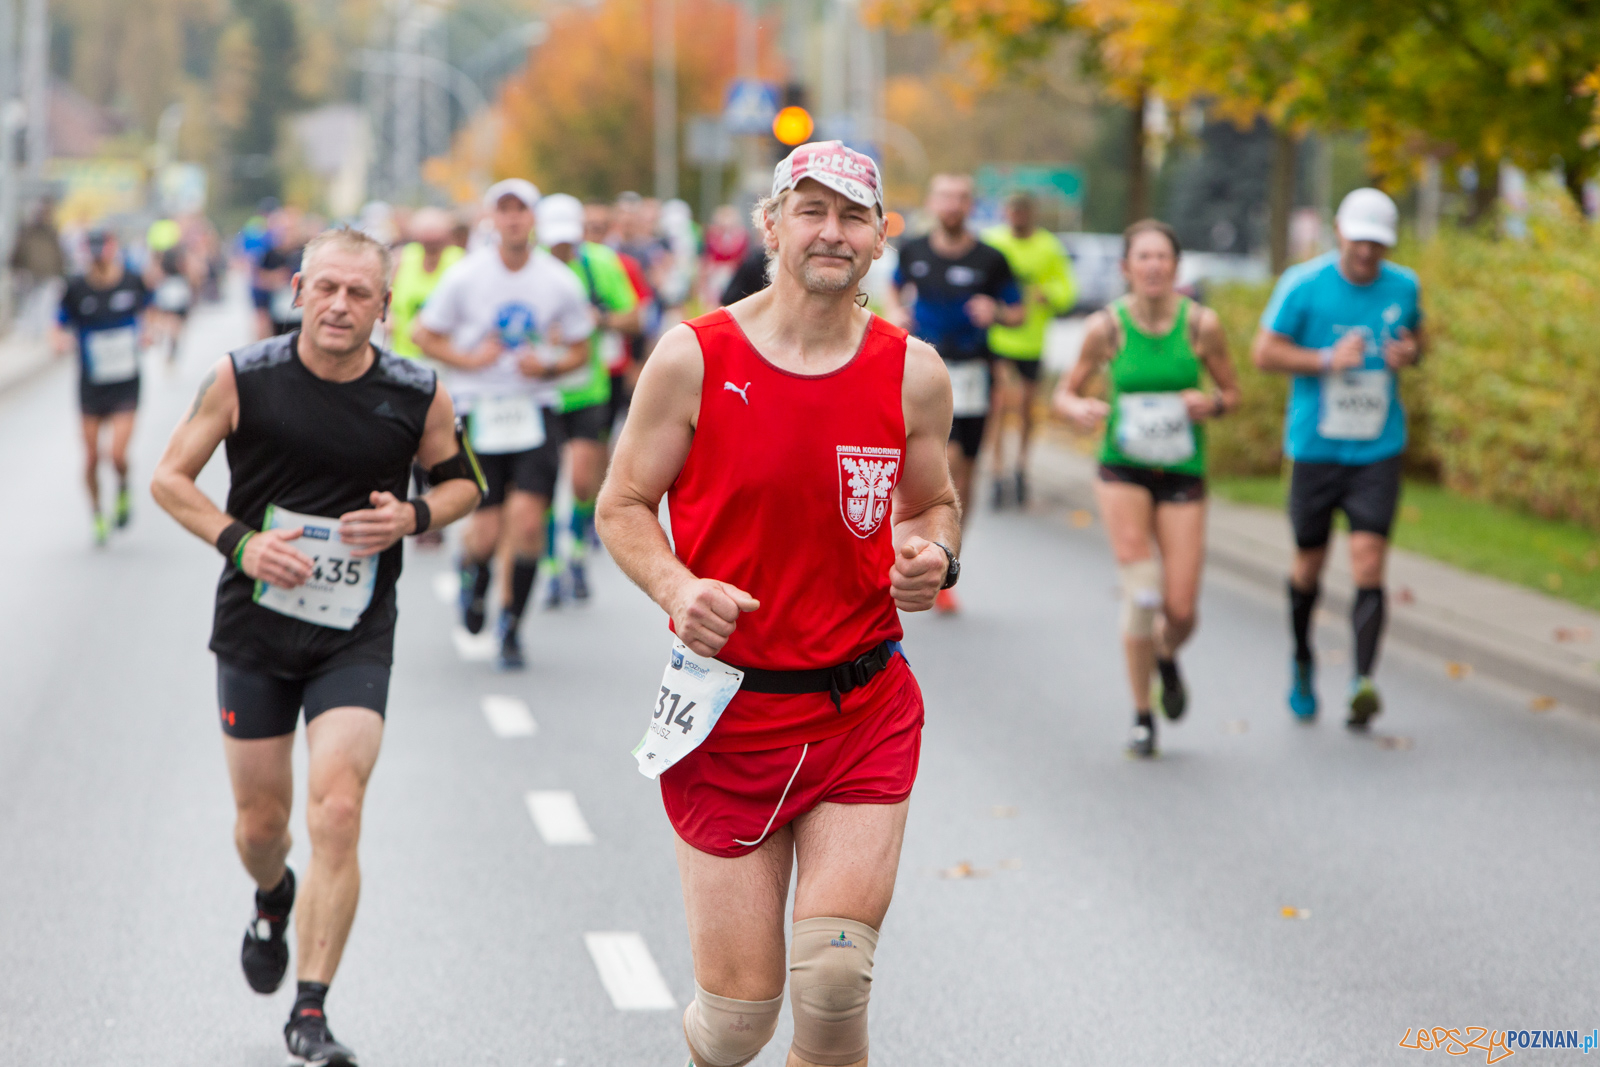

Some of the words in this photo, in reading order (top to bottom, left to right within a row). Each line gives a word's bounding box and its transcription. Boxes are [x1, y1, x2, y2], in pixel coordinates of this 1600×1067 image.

[836, 445, 861, 453] GMINA
[862, 446, 901, 456] KOMORNIKI
[653, 685, 697, 735] 314
[651, 722, 671, 740] RIUSZ
